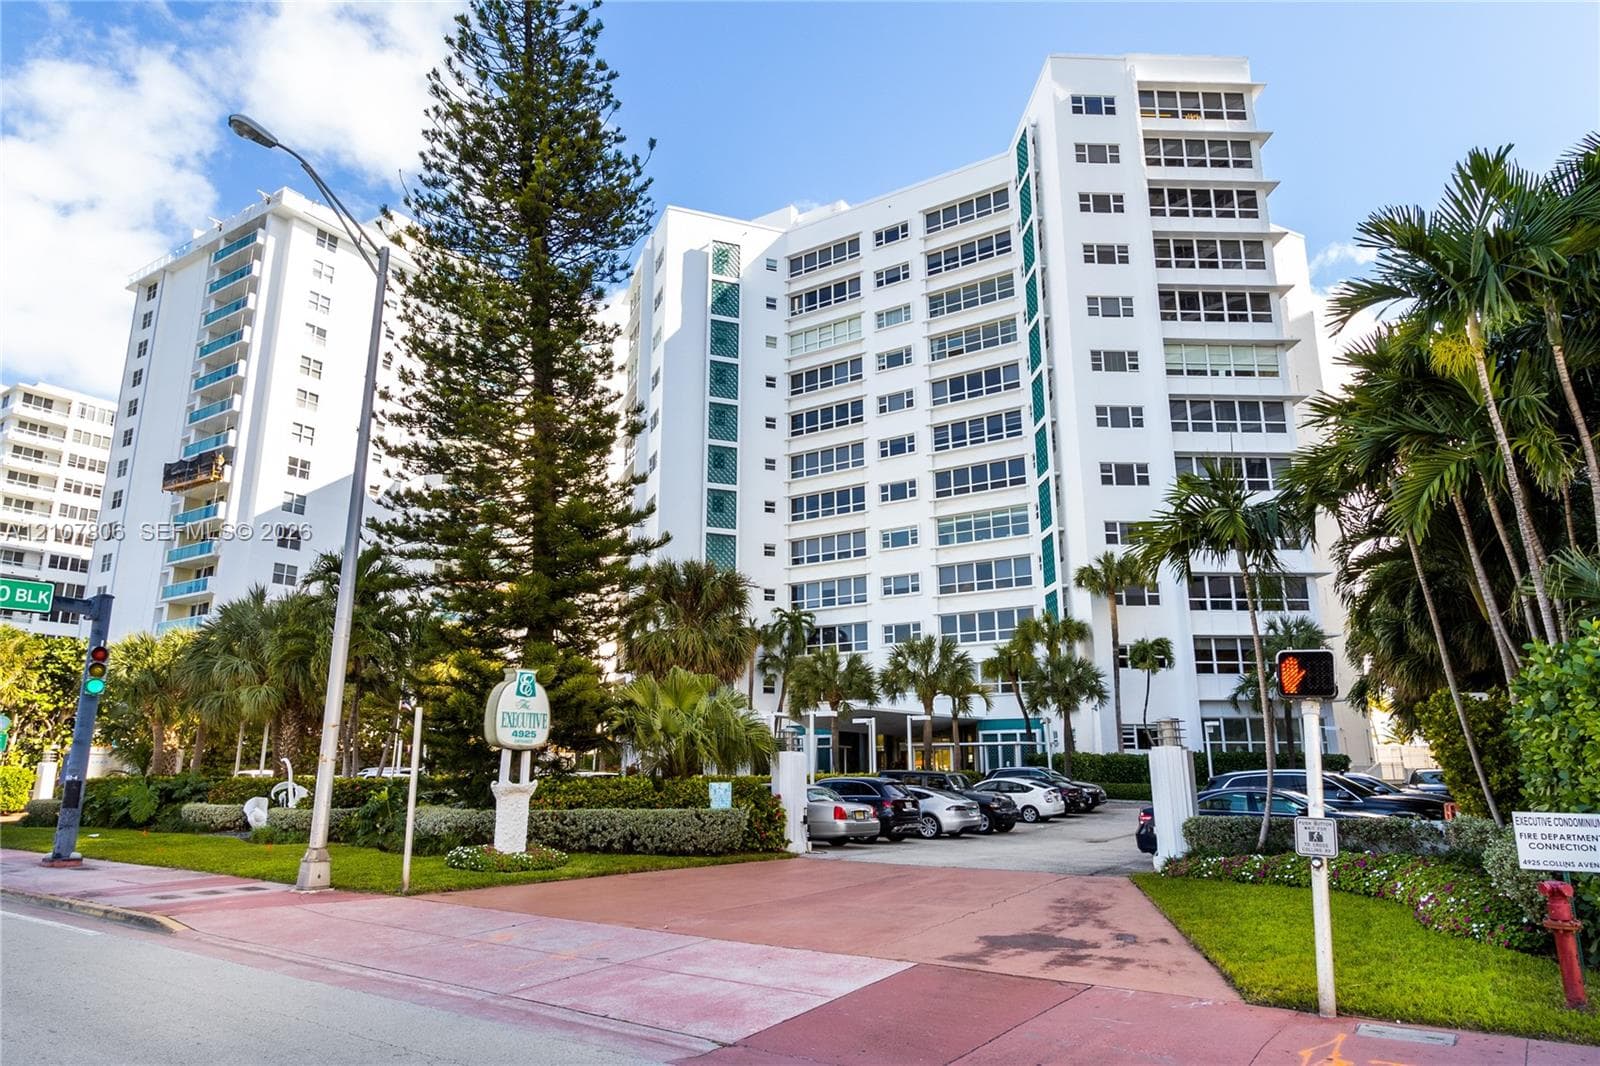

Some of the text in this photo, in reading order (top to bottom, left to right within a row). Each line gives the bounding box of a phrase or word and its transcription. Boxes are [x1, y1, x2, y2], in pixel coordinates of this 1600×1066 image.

[15, 588, 50, 605] BLK
[501, 711, 547, 729] EXECUTIVE
[511, 730, 537, 738] 4925
[1515, 816, 1553, 827] EXECUTIVE
[1519, 832, 1538, 840] FIRE
[1528, 842, 1597, 852] CONNECTION
[1542, 860, 1576, 868] COLLINS
[1577, 861, 1600, 869] AVEN
